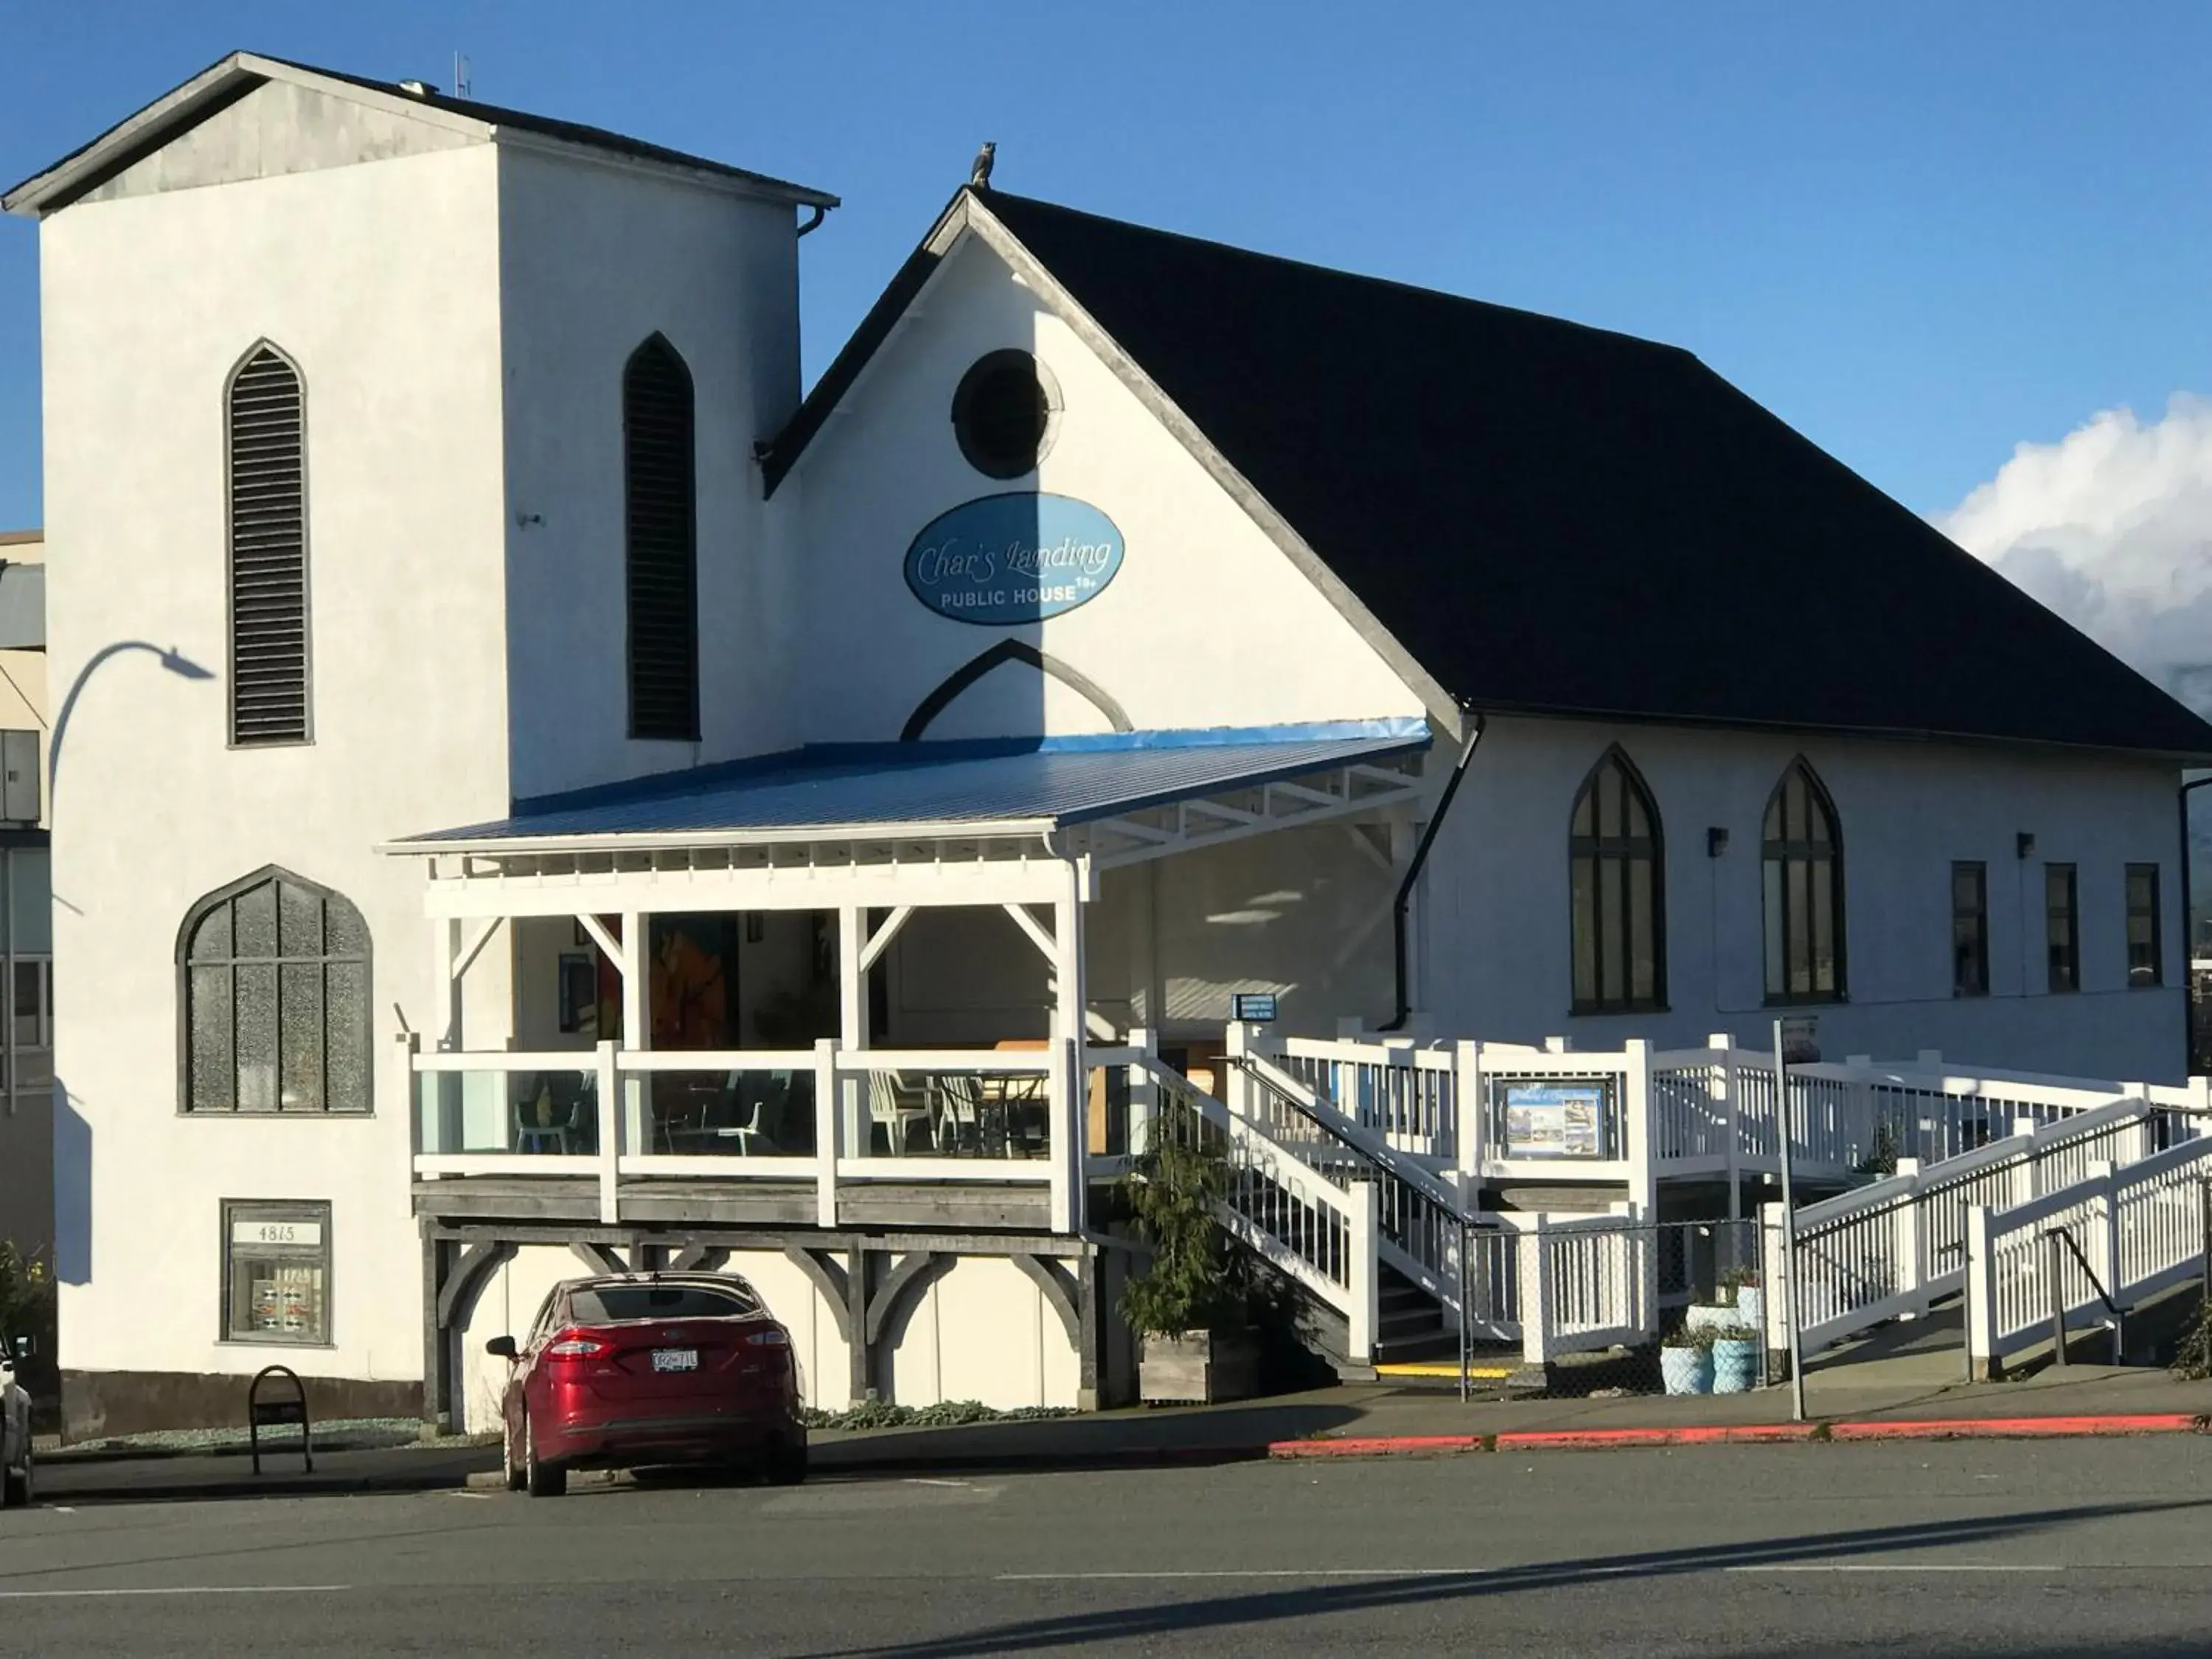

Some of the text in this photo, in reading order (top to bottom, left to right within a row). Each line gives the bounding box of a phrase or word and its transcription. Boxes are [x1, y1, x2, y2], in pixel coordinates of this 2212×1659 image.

[918, 537, 1112, 585] Char's Landing
[941, 585, 1077, 608] PUBLIC HOUSE
[259, 1225, 295, 1242] 4815
